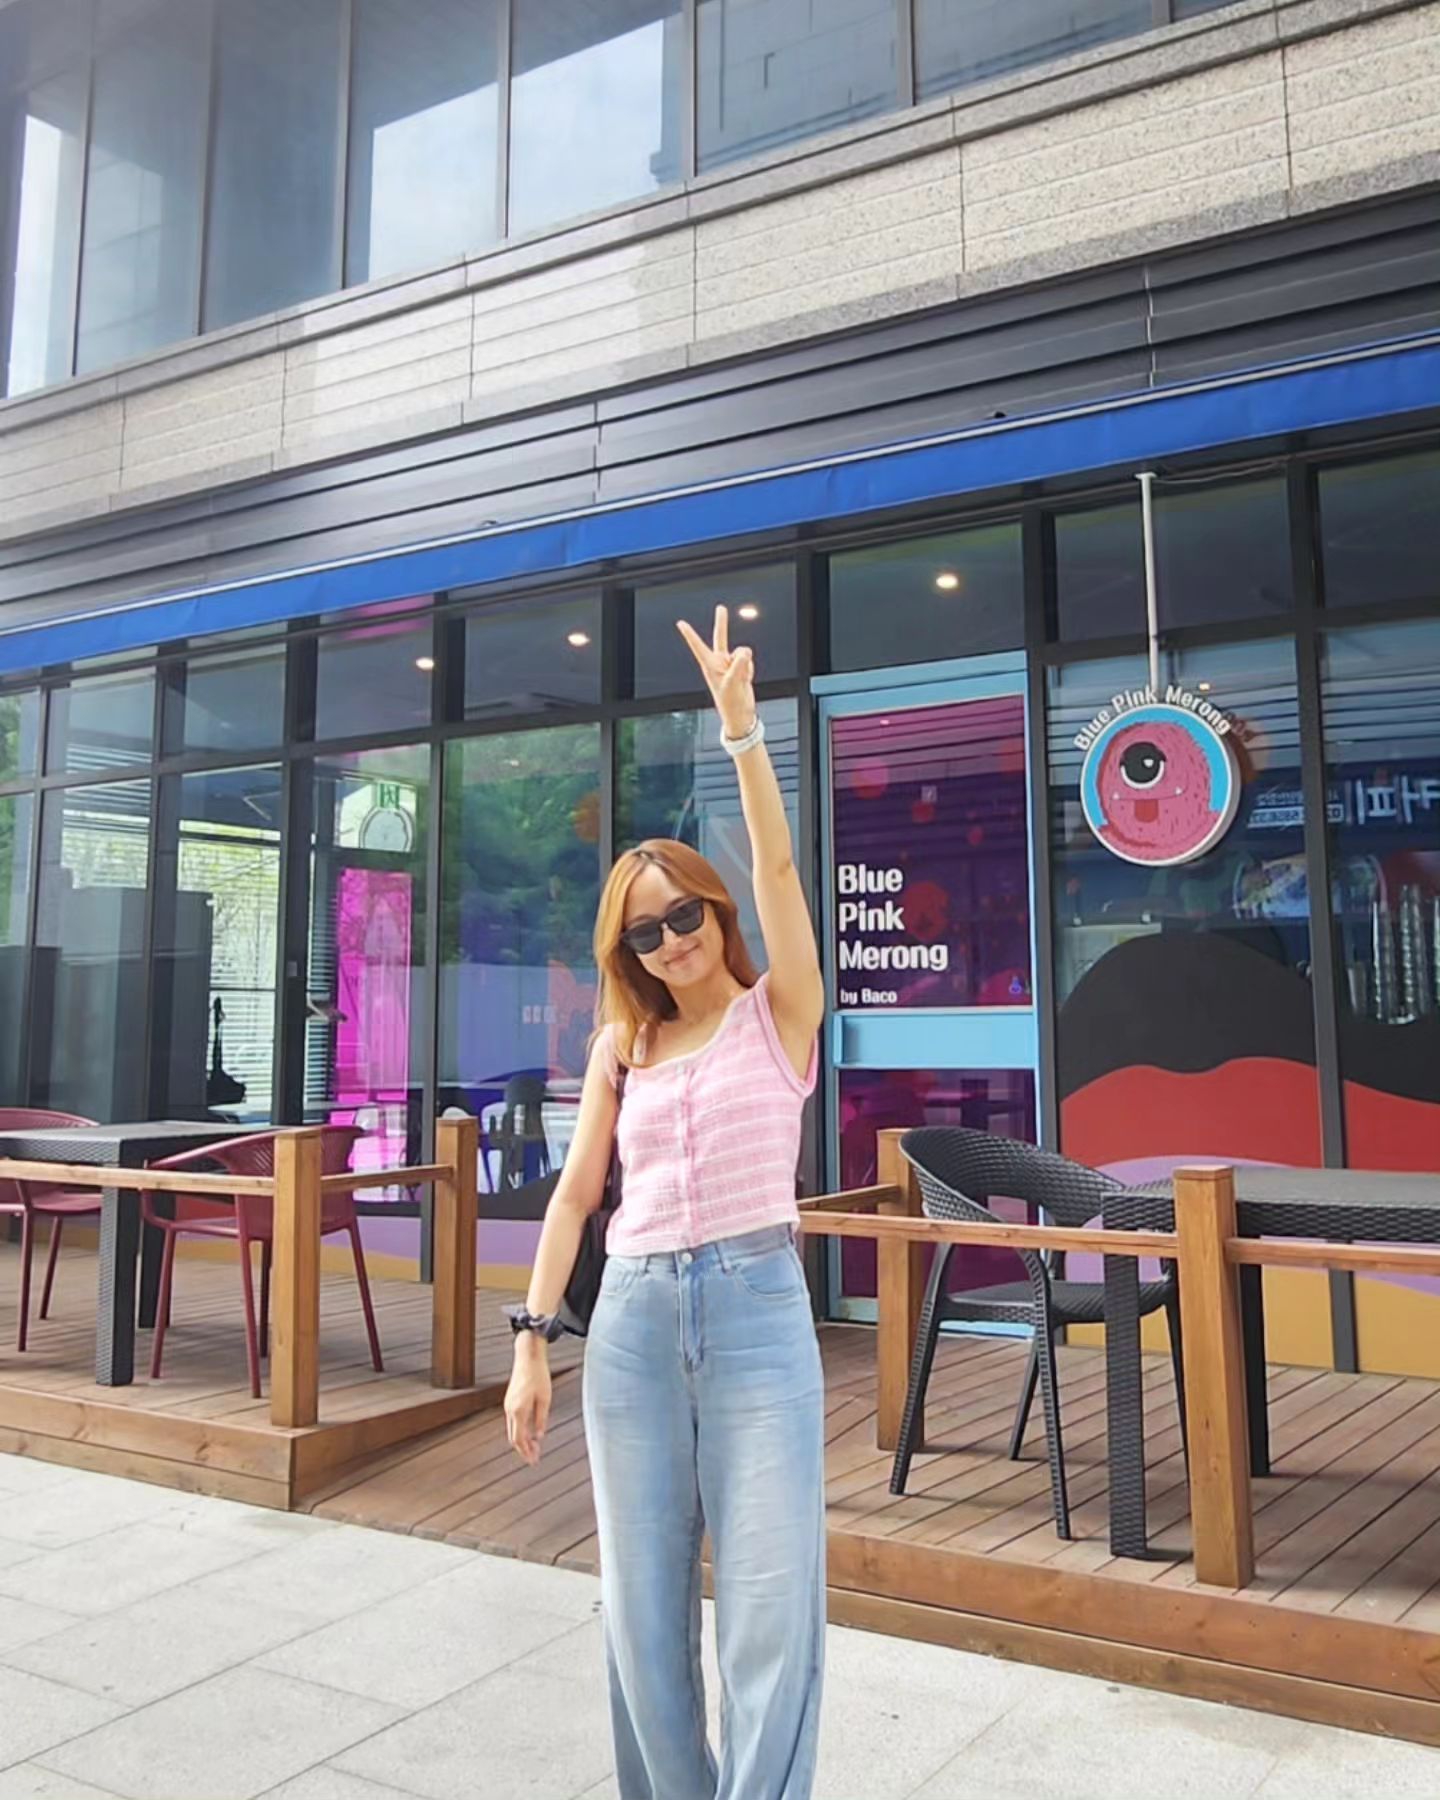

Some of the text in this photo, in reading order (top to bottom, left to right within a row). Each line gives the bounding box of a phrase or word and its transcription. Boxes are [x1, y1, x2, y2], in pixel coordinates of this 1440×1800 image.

[1073, 685, 1232, 750] Blue Pink Merong
[838, 864, 903, 894] Blue
[839, 900, 905, 932] Pink
[839, 940, 948, 971] Merong
[840, 988, 897, 1005] by Baco
